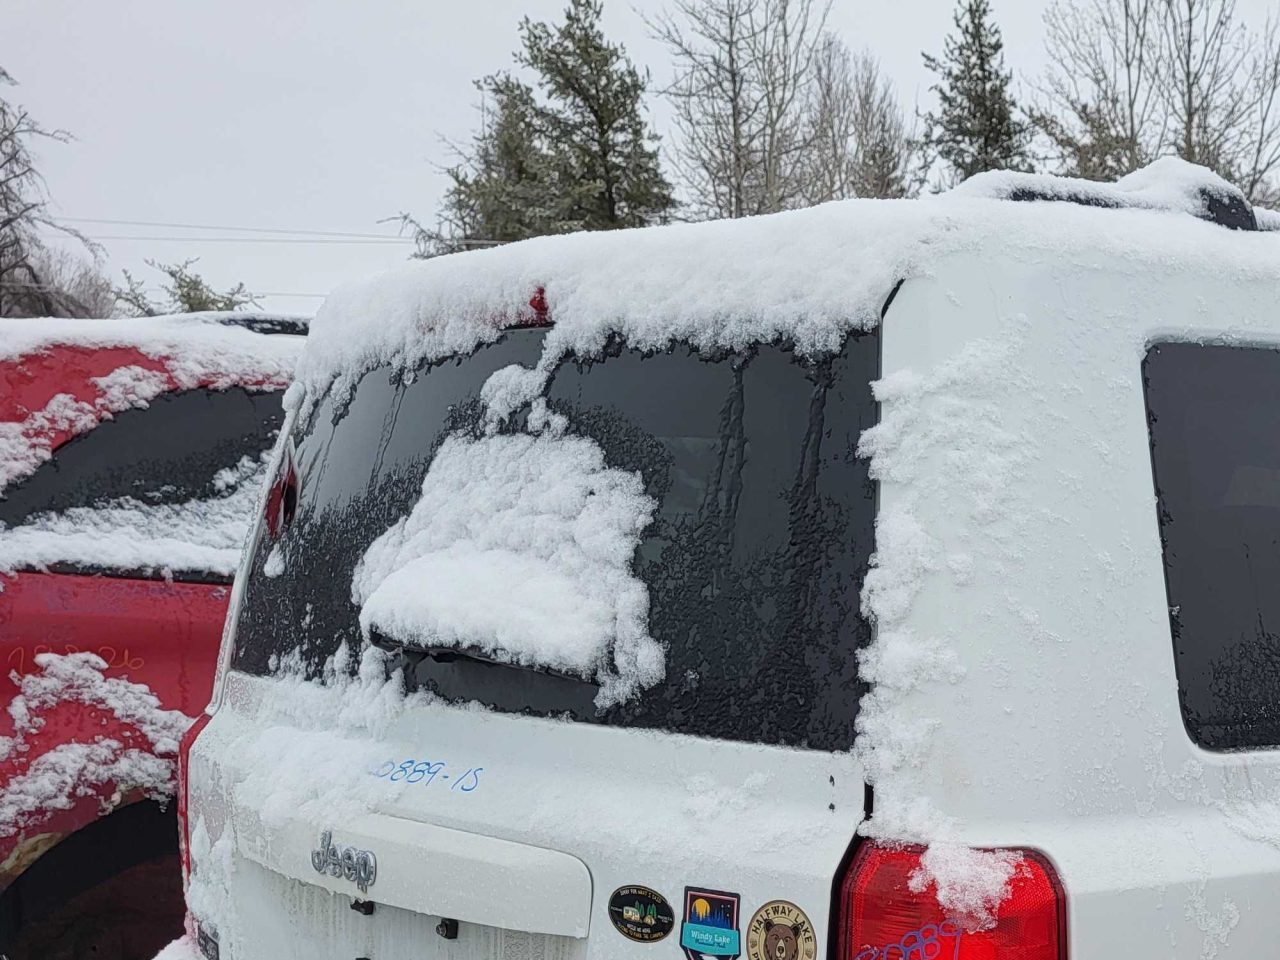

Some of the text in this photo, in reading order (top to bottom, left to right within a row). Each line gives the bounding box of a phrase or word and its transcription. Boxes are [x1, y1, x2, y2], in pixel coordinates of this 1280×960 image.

[311, 830, 377, 894] Jeep
[690, 929, 713, 942] Windy
[714, 933, 731, 944] Lake
[751, 905, 813, 943] HALFWAY LAKE
